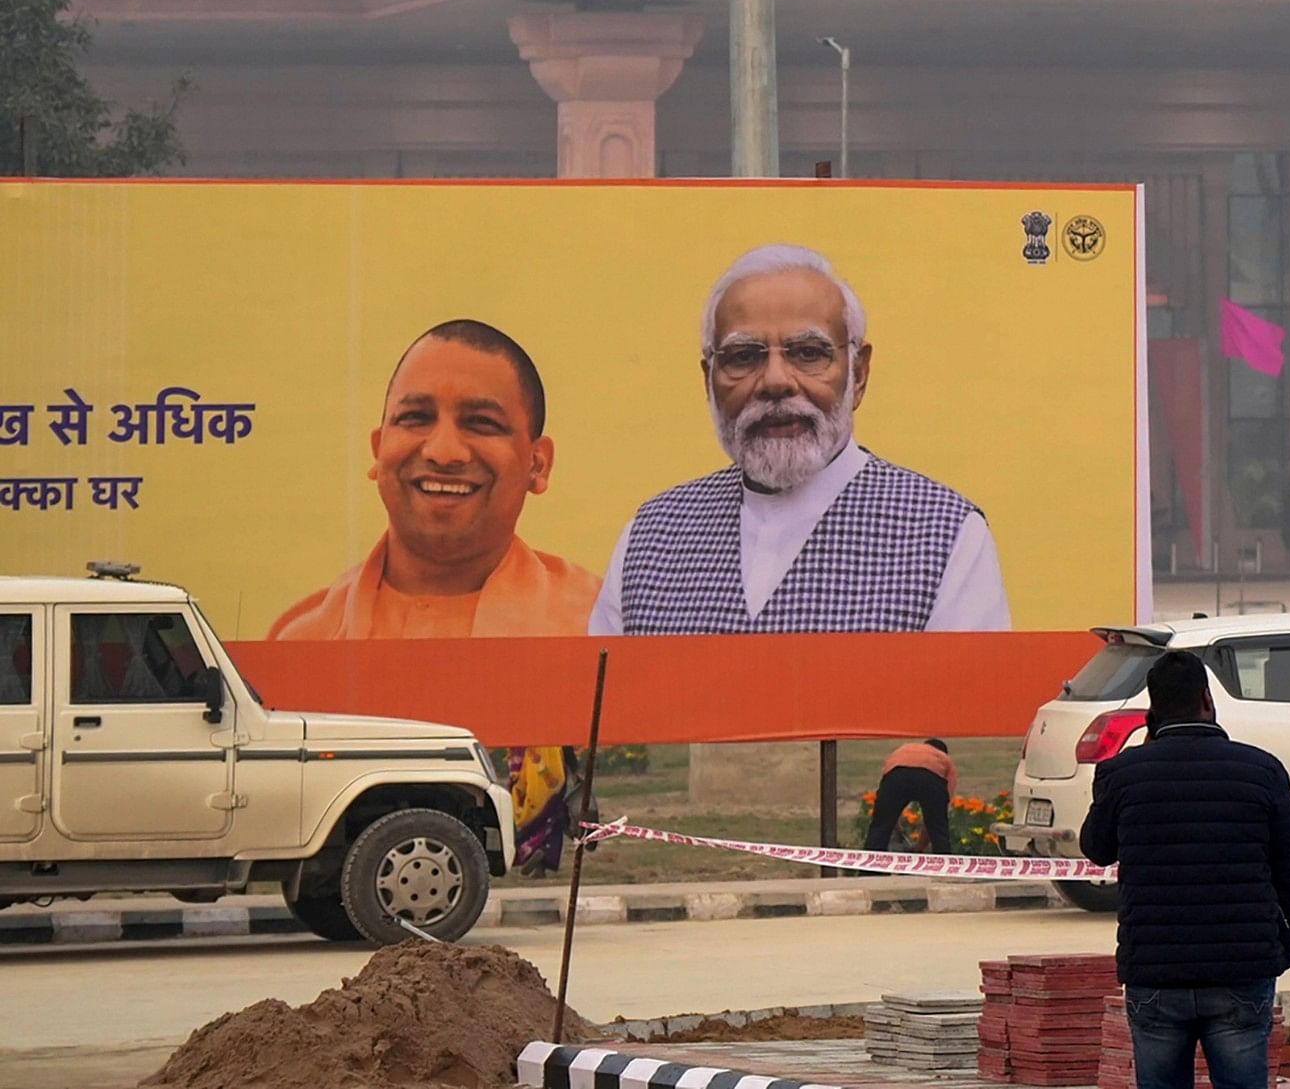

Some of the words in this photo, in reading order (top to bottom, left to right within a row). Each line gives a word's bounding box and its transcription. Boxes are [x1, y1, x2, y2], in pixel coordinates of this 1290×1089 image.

[47, 388, 93, 446] से
[107, 386, 256, 445] अधिक
[88, 476, 144, 510] घर
